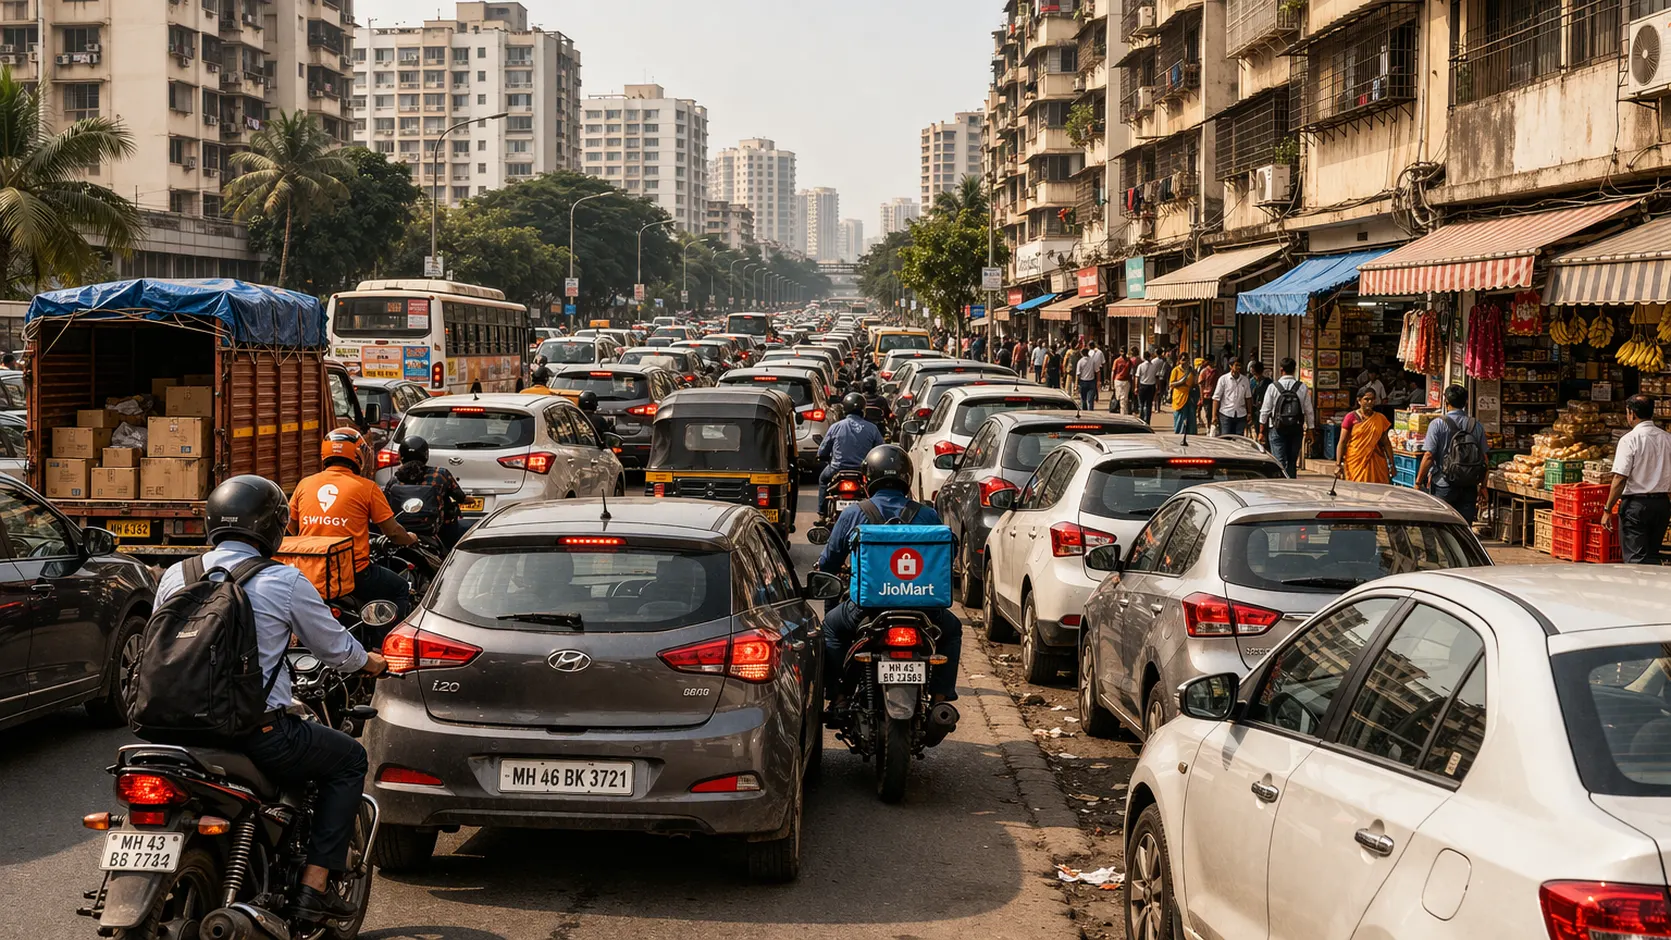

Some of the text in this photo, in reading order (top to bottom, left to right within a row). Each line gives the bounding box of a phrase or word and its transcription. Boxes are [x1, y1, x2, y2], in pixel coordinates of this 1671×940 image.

[303, 515, 348, 526] SWIGGY
[878, 582, 935, 596] JioMart
[512, 767, 626, 788] MH 46 BK 3721
[121, 835, 166, 851] MH 43
